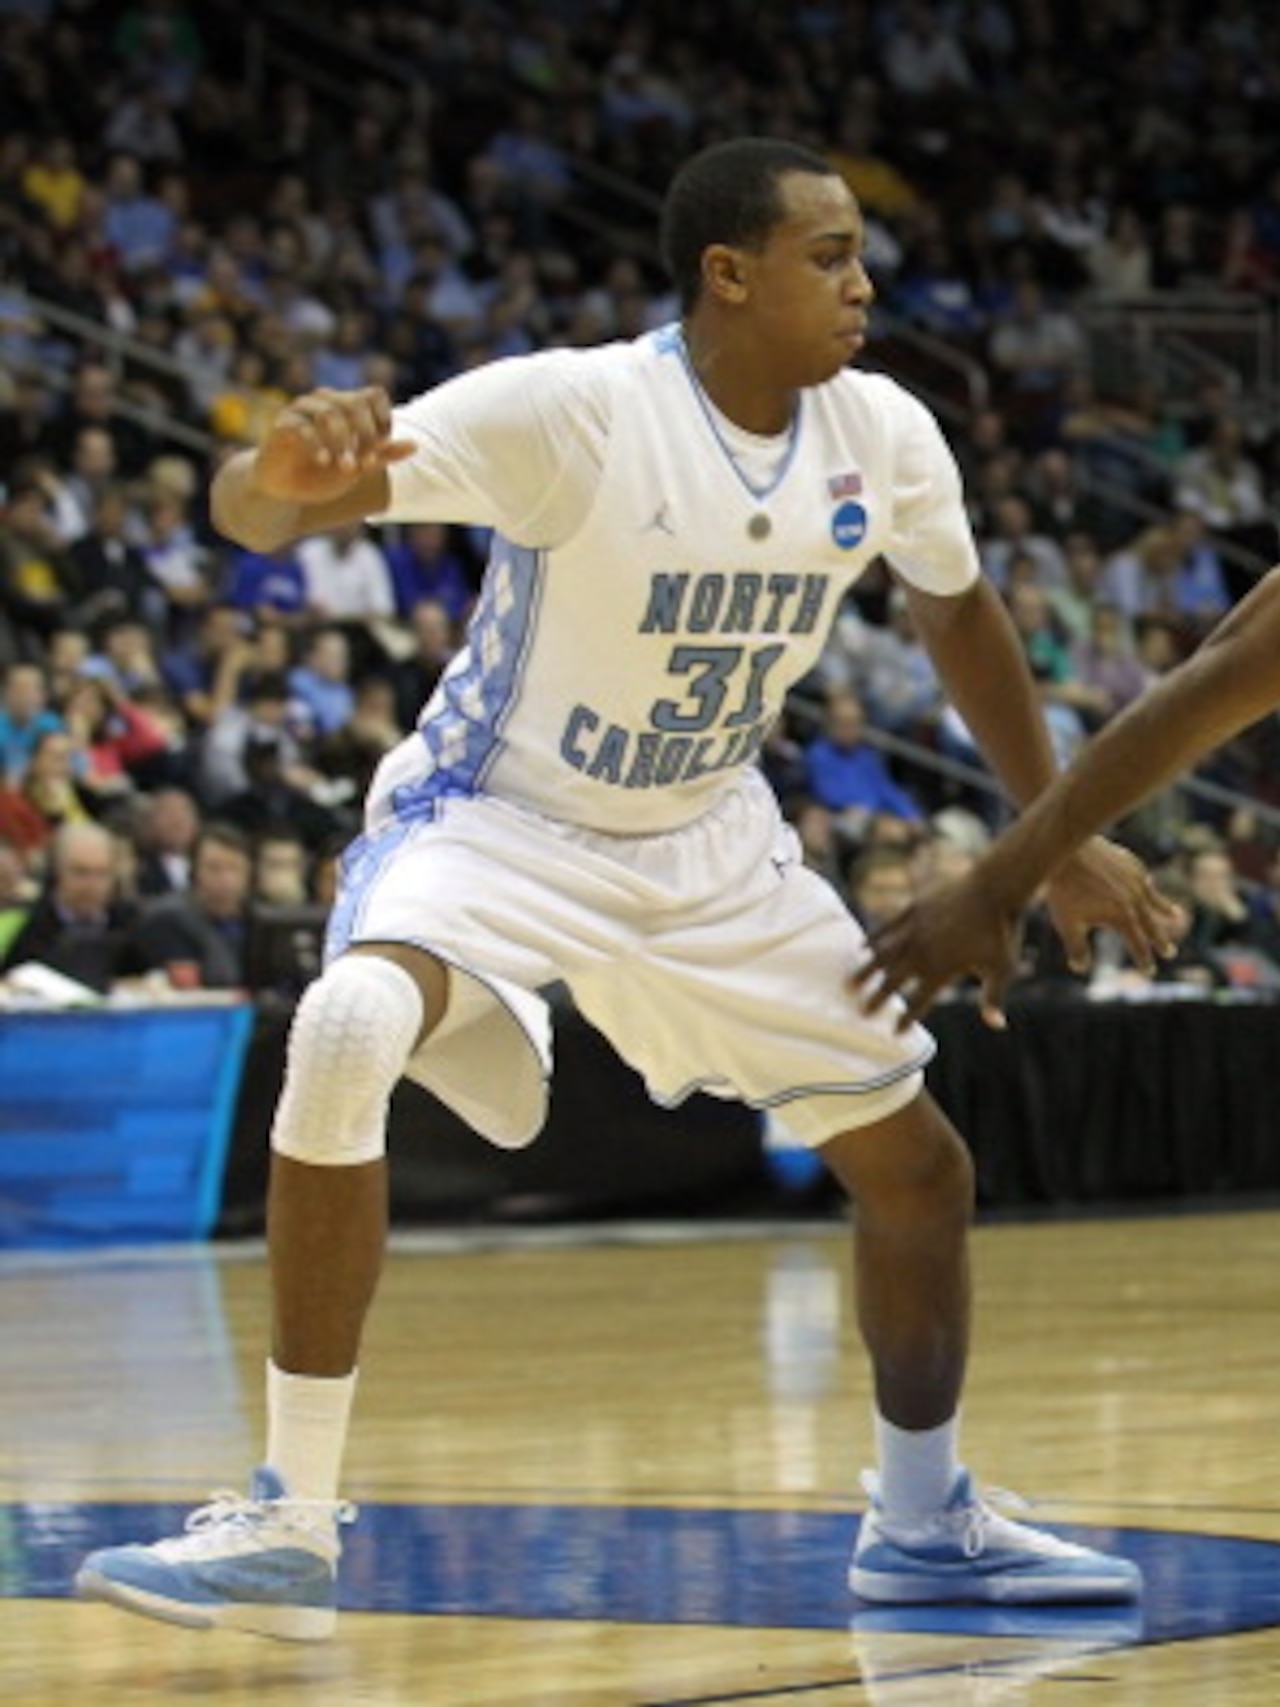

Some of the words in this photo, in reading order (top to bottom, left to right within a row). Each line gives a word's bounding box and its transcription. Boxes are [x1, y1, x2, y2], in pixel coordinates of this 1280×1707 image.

[638, 573, 828, 634] NORTH
[649, 643, 786, 732] 31
[560, 703, 772, 788] CAROLIN
